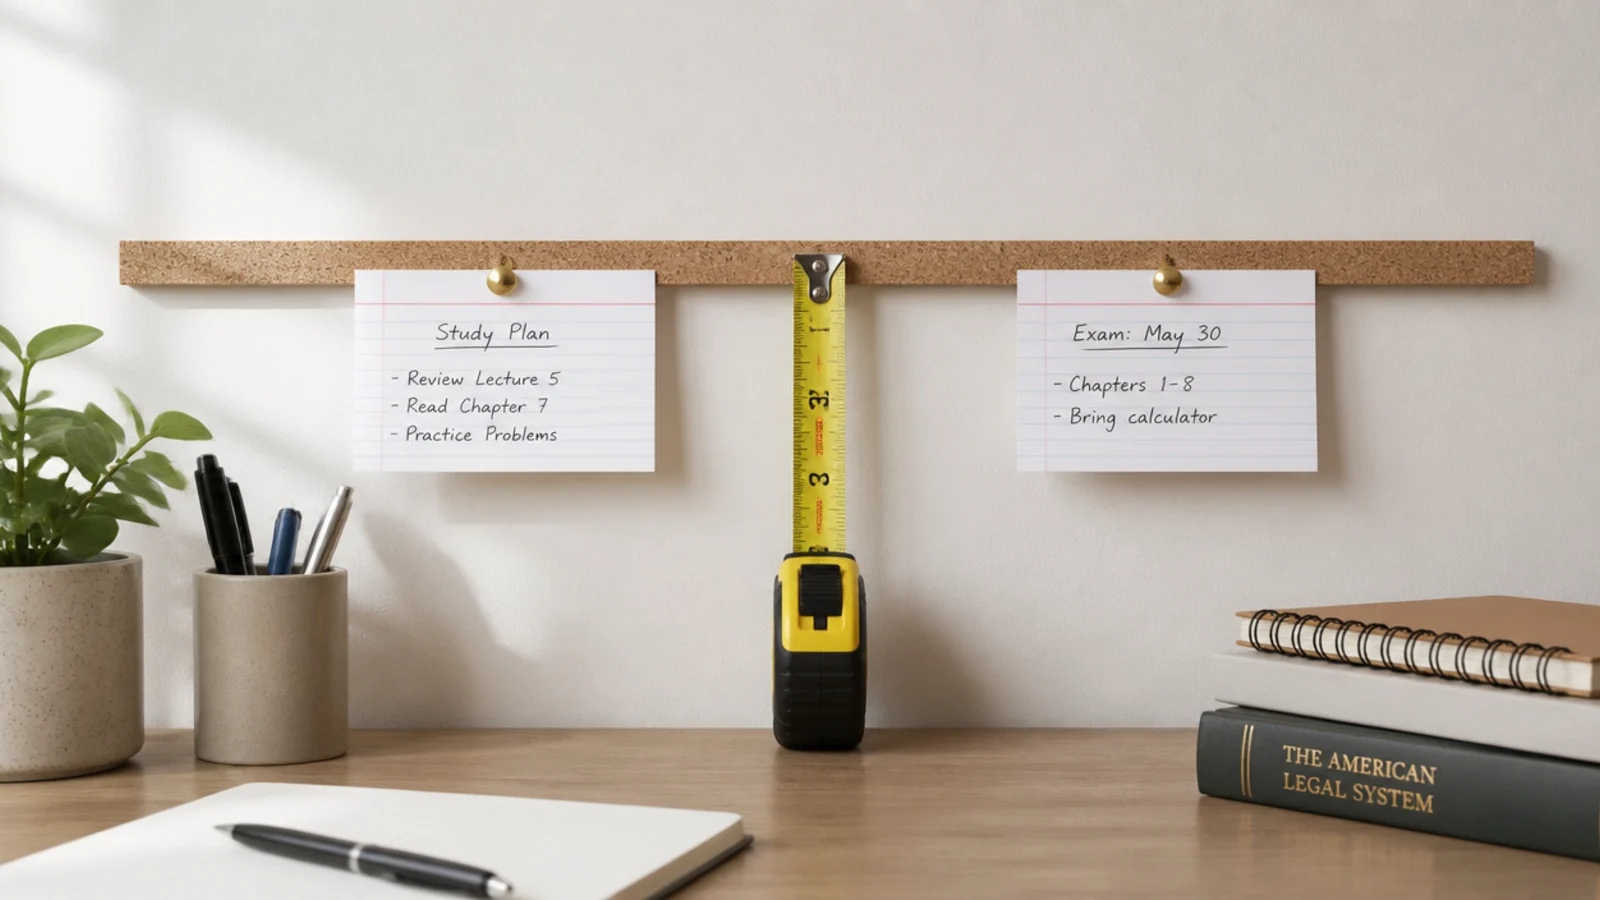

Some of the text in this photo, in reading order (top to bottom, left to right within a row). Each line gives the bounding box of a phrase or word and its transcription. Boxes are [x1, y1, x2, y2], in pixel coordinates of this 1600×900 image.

[435, 322, 550, 352] Study Plan
[1073, 323, 1222, 354] Exam: May 30
[407, 370, 464, 386] Review
[475, 370, 539, 386] Lecture
[548, 371, 561, 386] 5
[1069, 375, 1146, 398] Chapters
[406, 397, 448, 414] Read
[459, 397, 527, 419] Chapter
[538, 397, 549, 413] 7
[1070, 407, 1116, 432] Bring
[1128, 407, 1218, 424] calculator
[405, 425, 473, 441] Practice
[485, 425, 557, 441] Problems
[1283, 745, 1437, 785] THE AMERICAN
[1283, 772, 1435, 813] LEGAL SYSTEM
